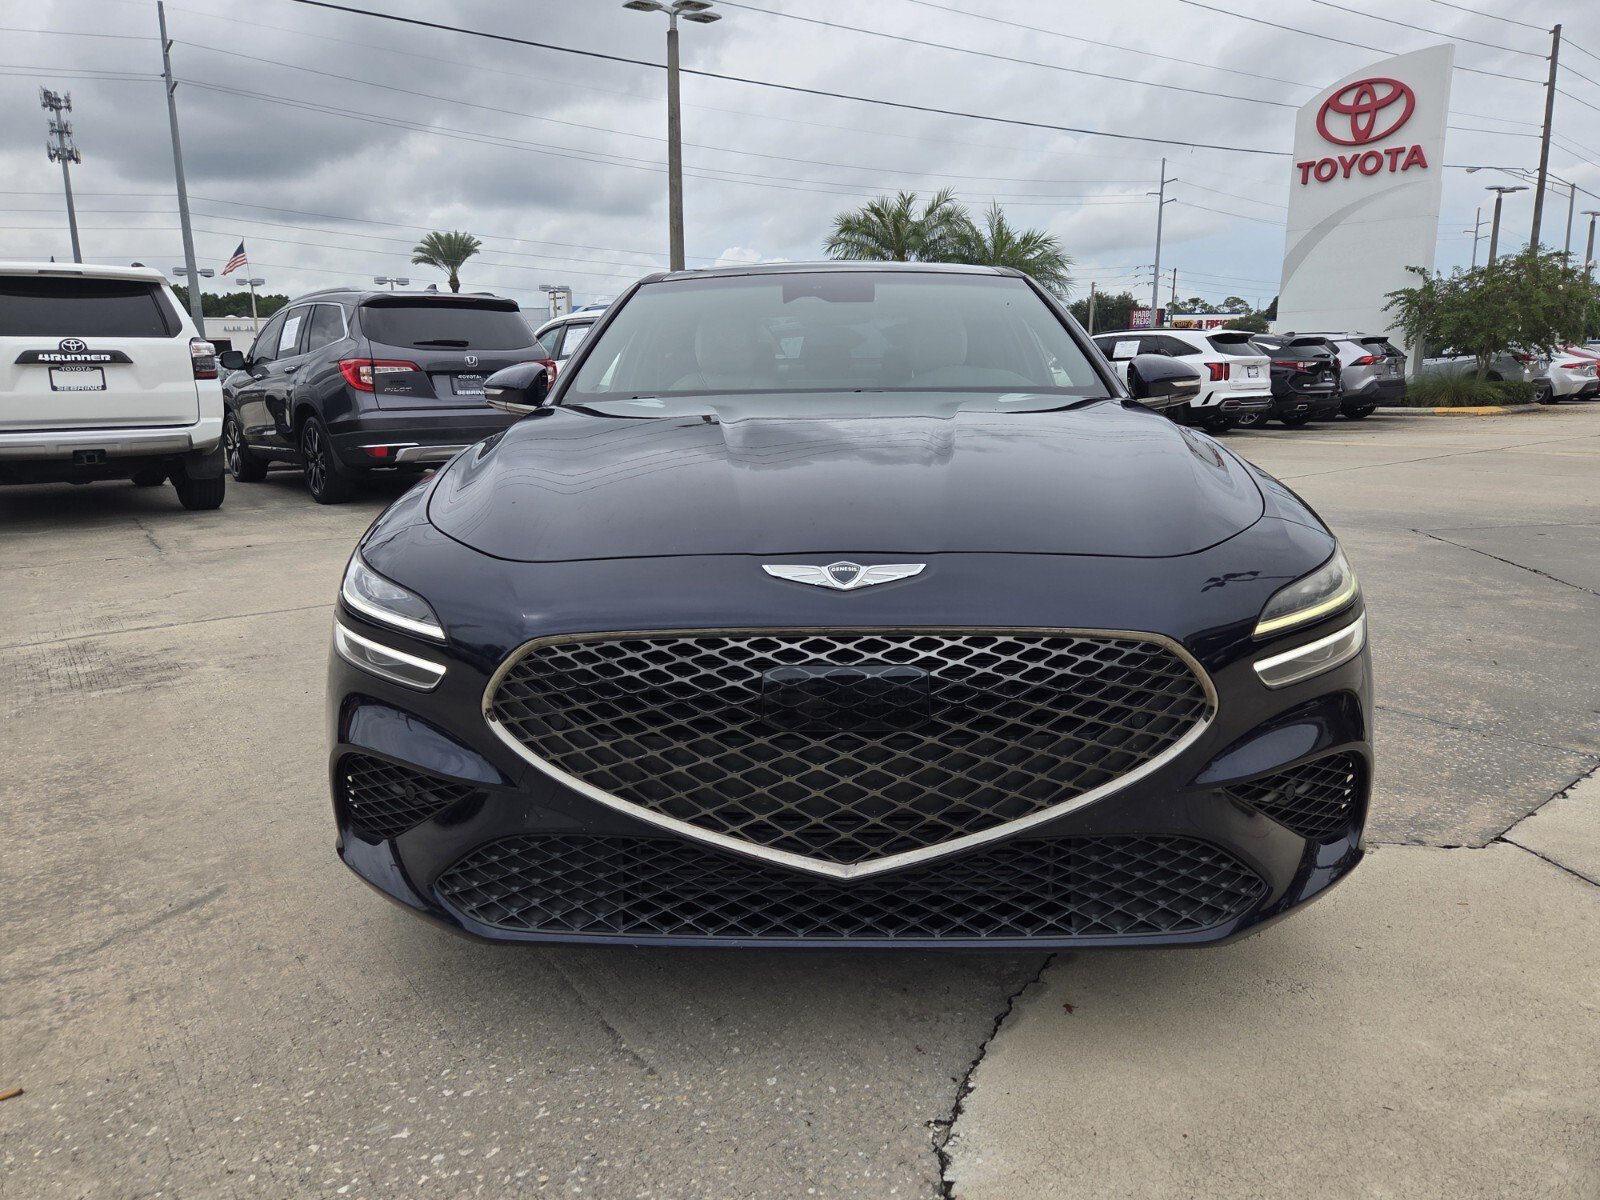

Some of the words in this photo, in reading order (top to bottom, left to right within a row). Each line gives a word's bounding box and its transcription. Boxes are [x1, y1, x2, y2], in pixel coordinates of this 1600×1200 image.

[1297, 145, 1428, 185] TOYOTA
[1133, 310, 1158, 318] HARB
[1132, 317, 1152, 326] FREIG
